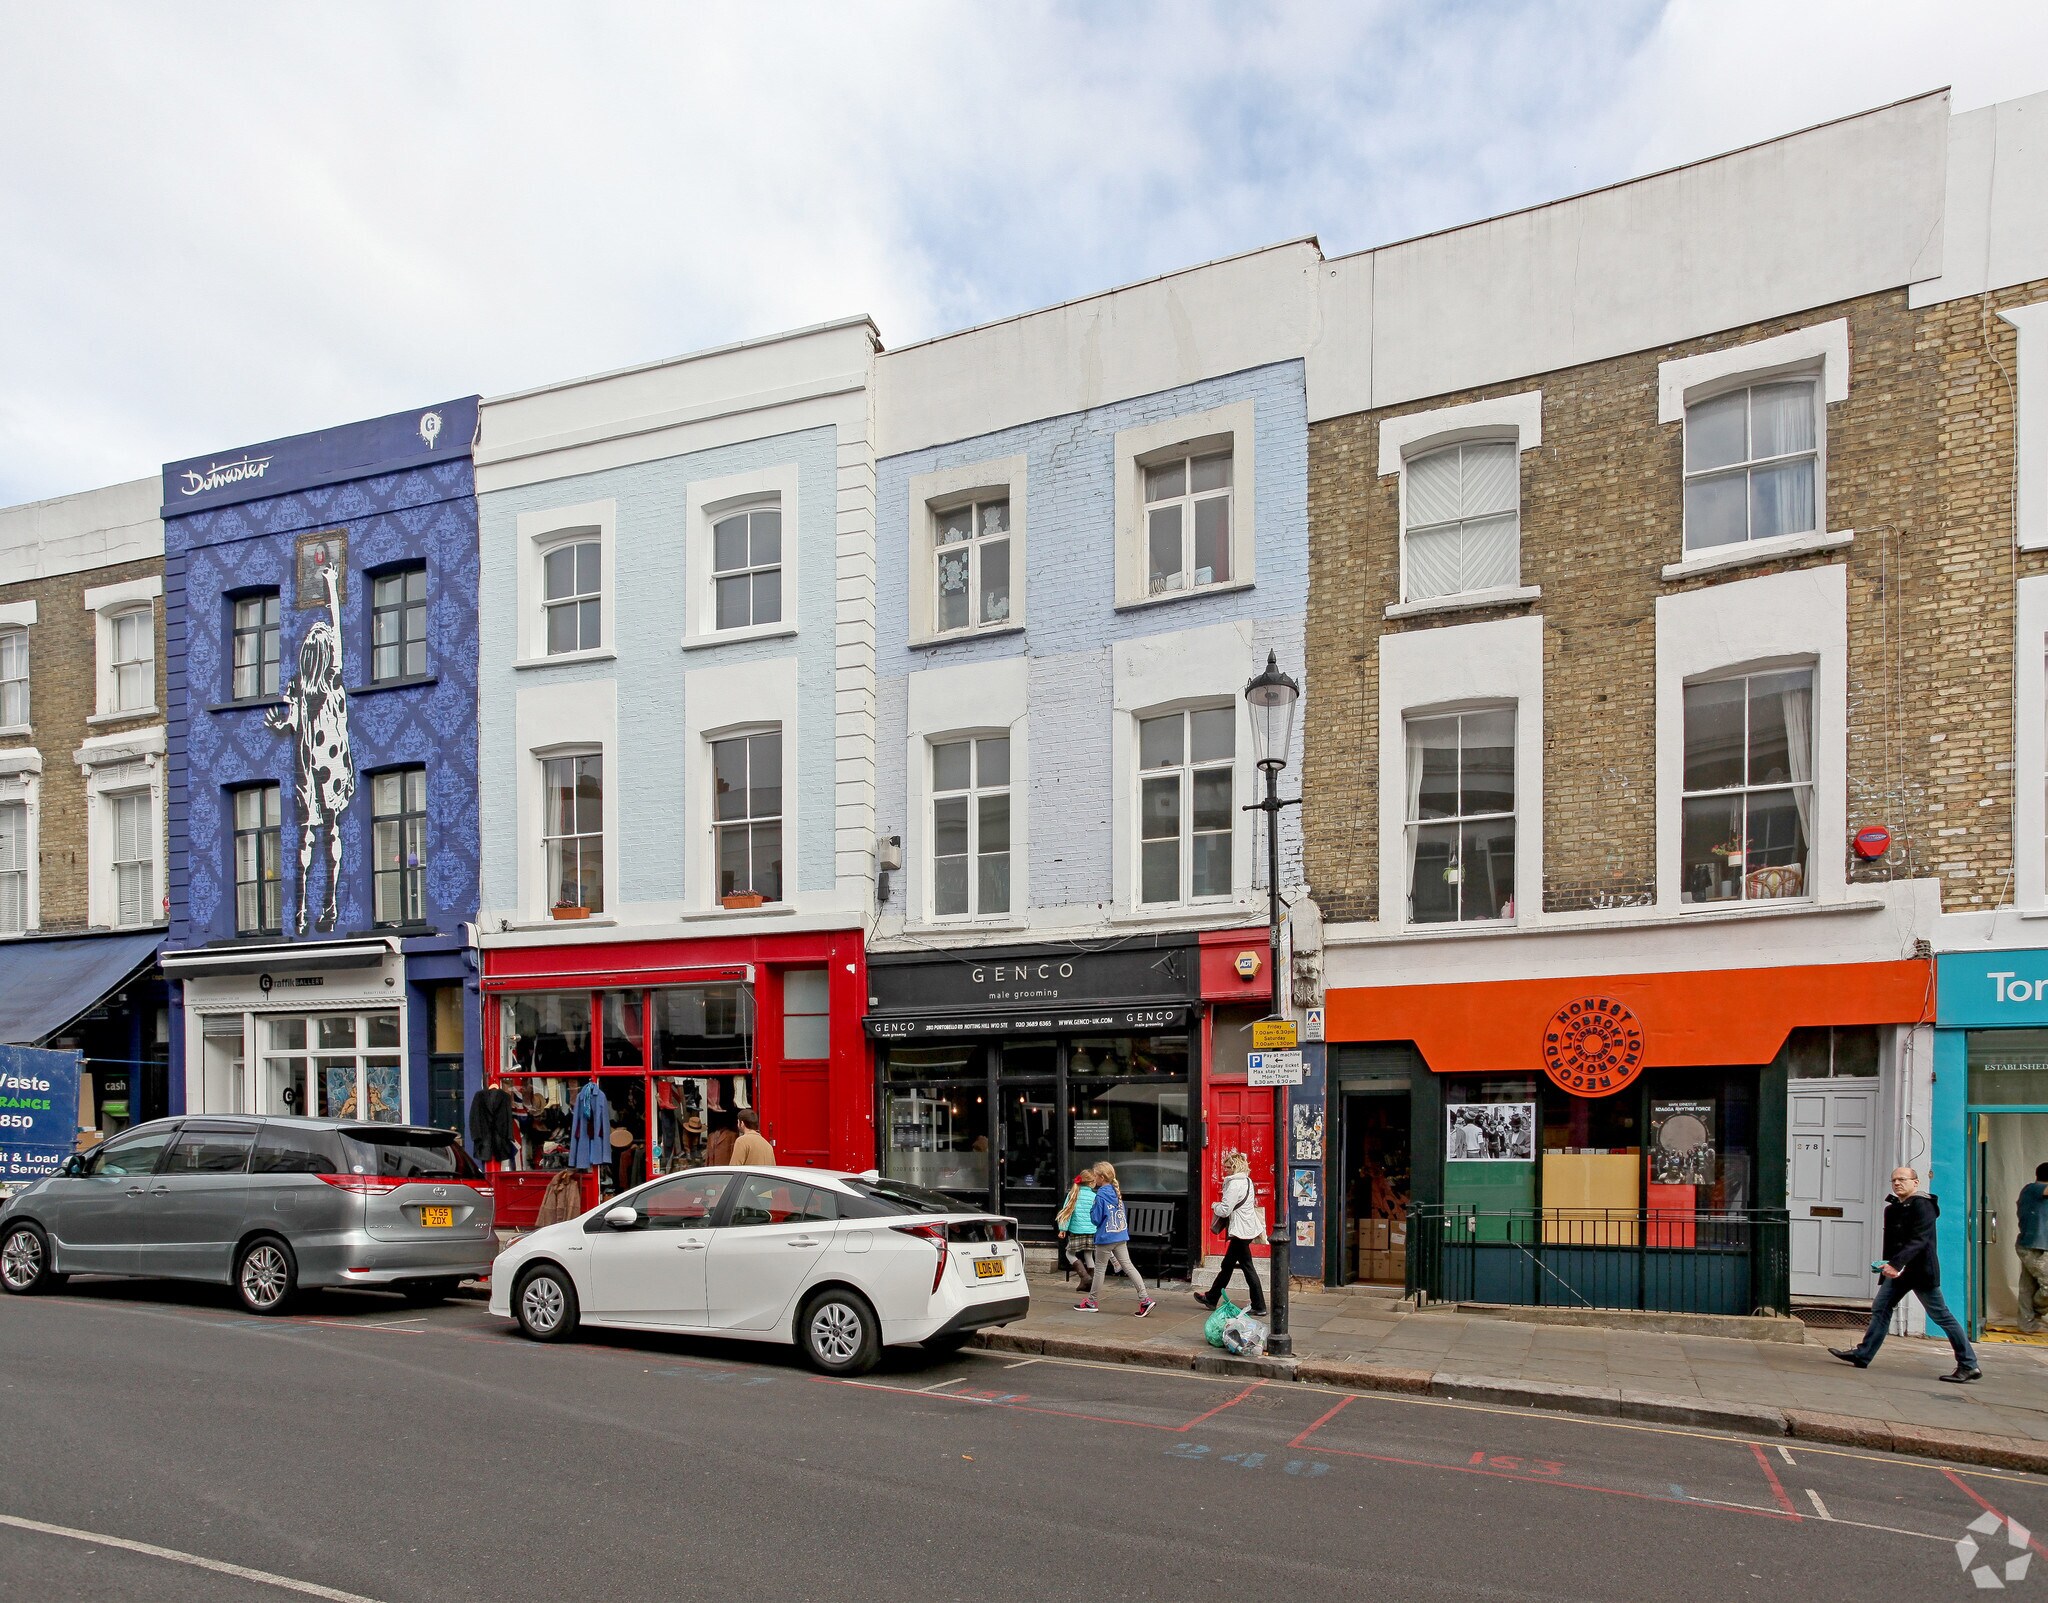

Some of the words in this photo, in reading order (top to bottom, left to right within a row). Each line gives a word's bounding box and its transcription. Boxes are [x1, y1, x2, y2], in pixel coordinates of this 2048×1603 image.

[972, 963, 1073, 983] GENCO
[989, 991, 1010, 999] male
[1014, 989, 1058, 999] grooming
[1126, 1011, 1174, 1022] GENCO
[1558, 999, 1632, 1024] HONEST
[875, 1023, 915, 1032] GENCO
[1563, 1015, 1624, 1050] LADBROKE
[1577, 1027, 1609, 1043] LONDON
[1575, 1042, 1611, 1062] ENGLAND
[1618, 1029, 1641, 1076] JONS
[1547, 1033, 1611, 1089] RECORDS
[1568, 1055, 1617, 1073] GROVE
[1984, 1063, 2048, 1071] ESTABLISHED
[105, 1080, 126, 1091] cash
[0, 1115, 33, 1128] 850
[1236, 1115, 1251, 1124] 280
[12, 1152, 22, 1162] &
[26, 1153, 59, 1163] Load
[428, 1208, 449, 1217] LY55
[431, 1216, 447, 1225] ZDX
